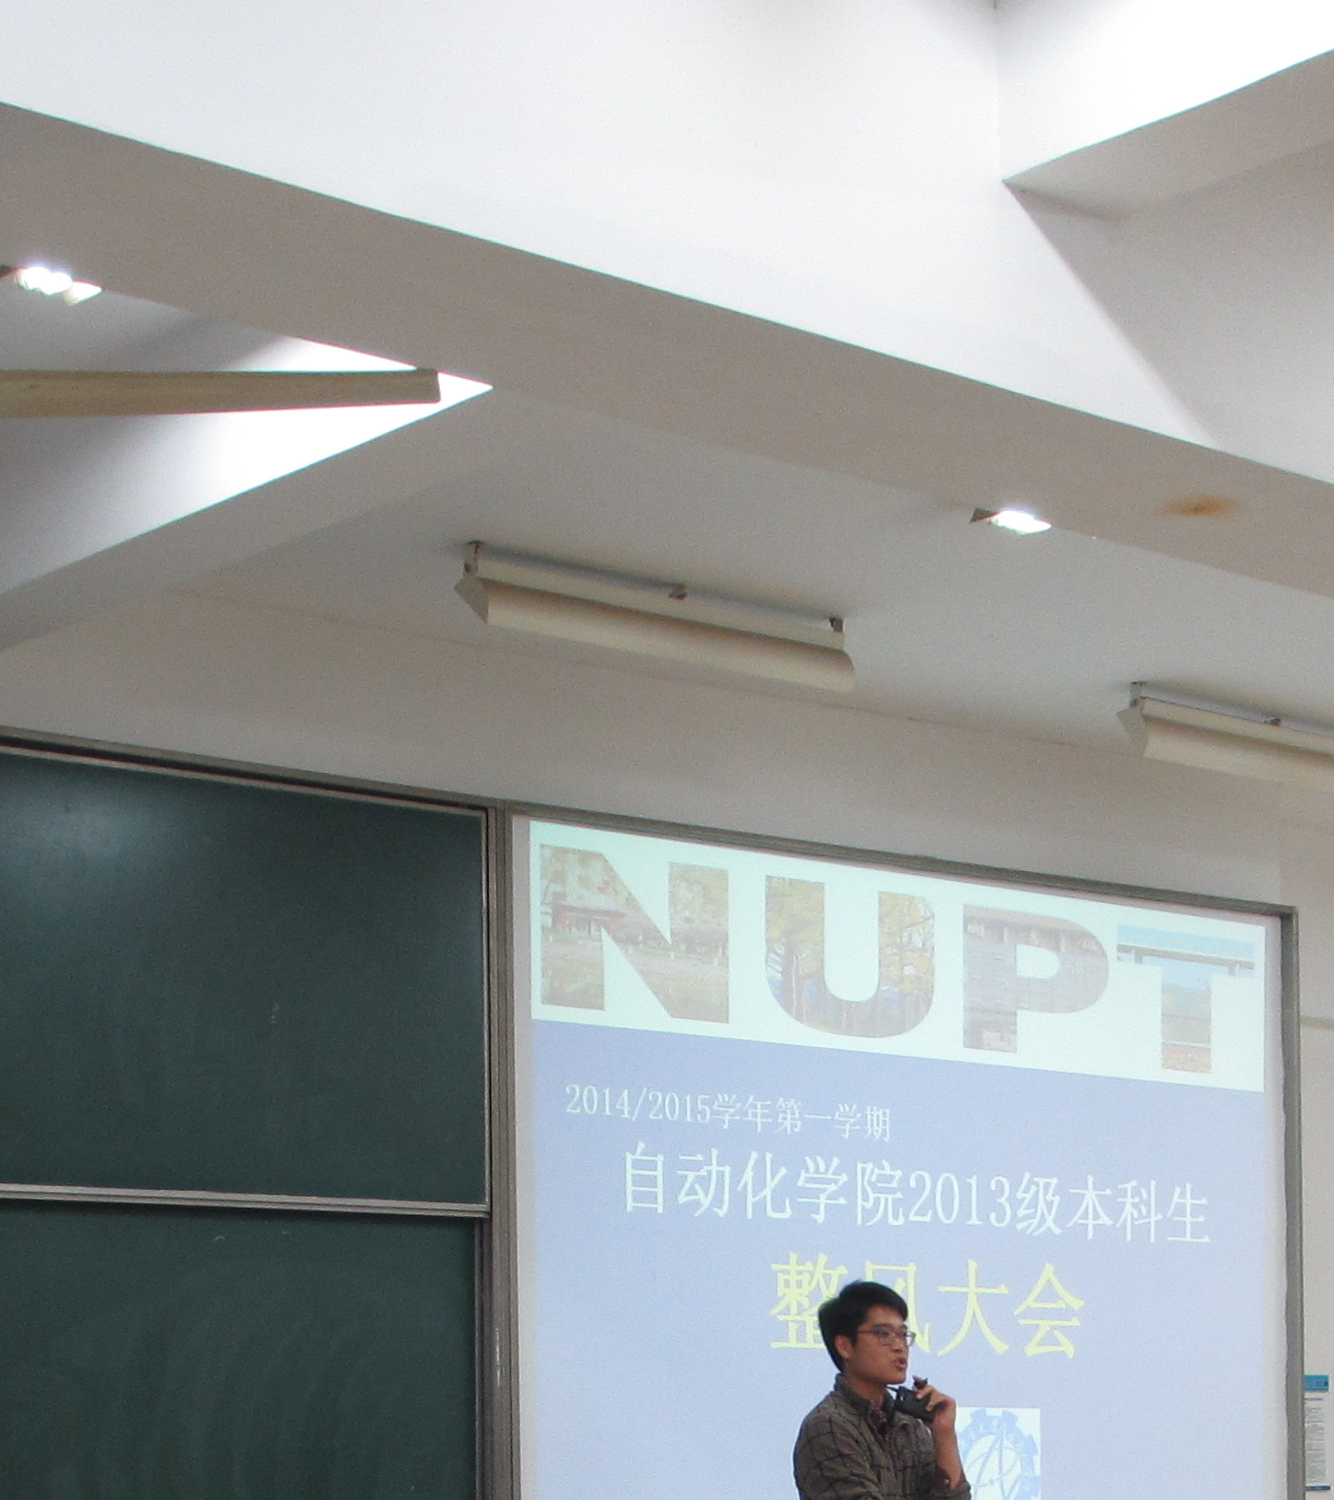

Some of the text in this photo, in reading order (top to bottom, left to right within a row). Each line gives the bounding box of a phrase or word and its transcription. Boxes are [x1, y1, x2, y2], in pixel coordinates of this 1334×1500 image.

[538, 842, 1256, 1074] NUPT
[564, 1084, 892, 1142] 2014/2015学年第一学期
[623, 1140, 1211, 1244] 自动化学院2013级本科生
